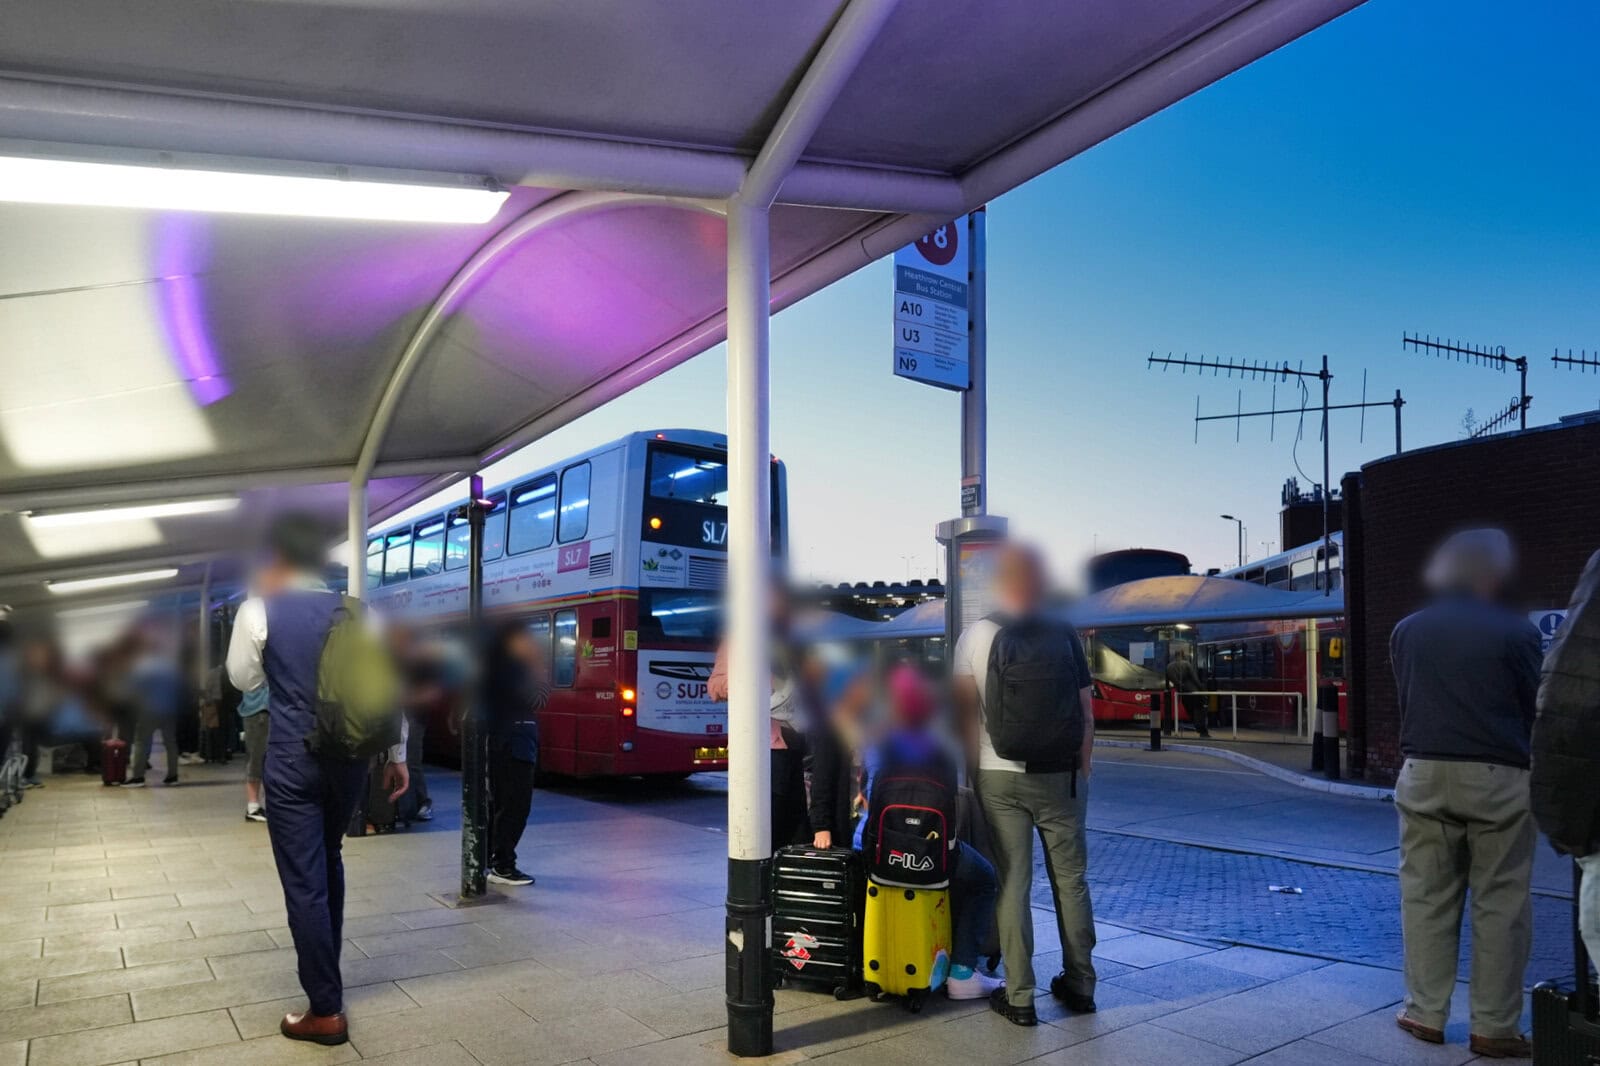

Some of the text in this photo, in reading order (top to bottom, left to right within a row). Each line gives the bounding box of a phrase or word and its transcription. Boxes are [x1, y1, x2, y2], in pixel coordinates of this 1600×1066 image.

[904, 269, 962, 293] Heathrow Central
[916, 283, 953, 299] Bus Station
[900, 300, 923, 317] A10
[902, 327, 920, 343] U3
[899, 356, 917, 371] N9
[702, 520, 728, 545] SL7
[563, 549, 582, 567] SL7
[888, 849, 935, 871] FILA
